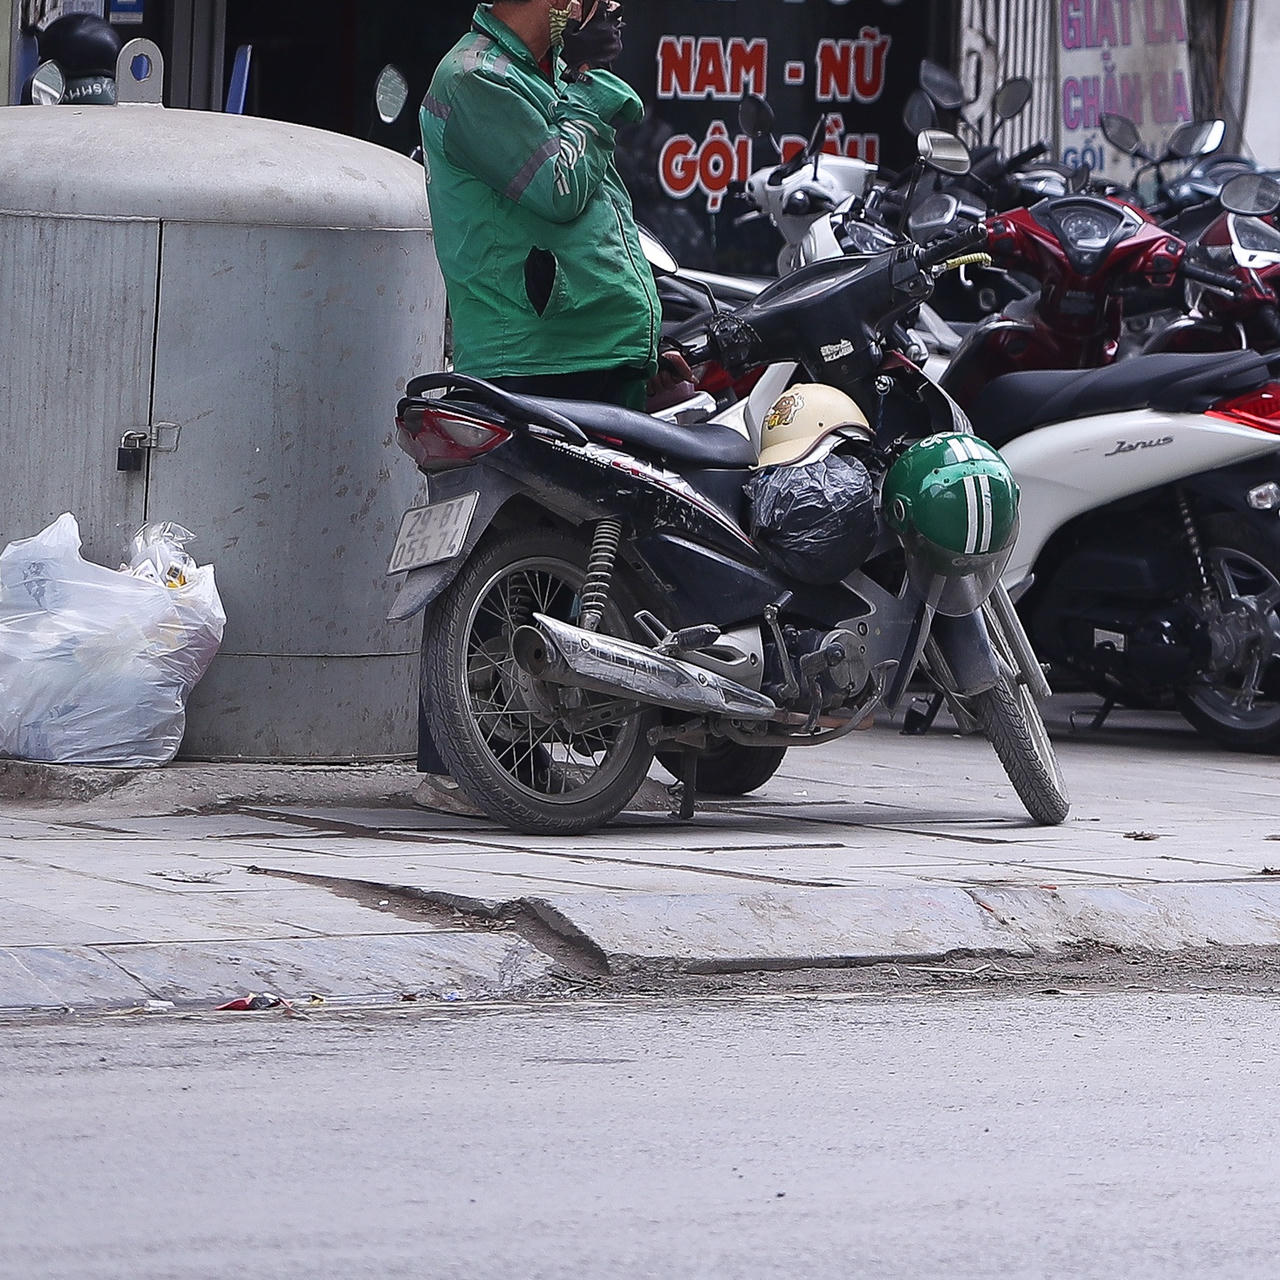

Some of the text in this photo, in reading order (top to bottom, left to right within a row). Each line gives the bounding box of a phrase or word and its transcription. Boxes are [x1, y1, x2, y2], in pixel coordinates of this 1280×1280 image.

[656, 36, 768, 100] NAM
[815, 28, 890, 102] NỮ
[659, 120, 752, 213] GỘI
